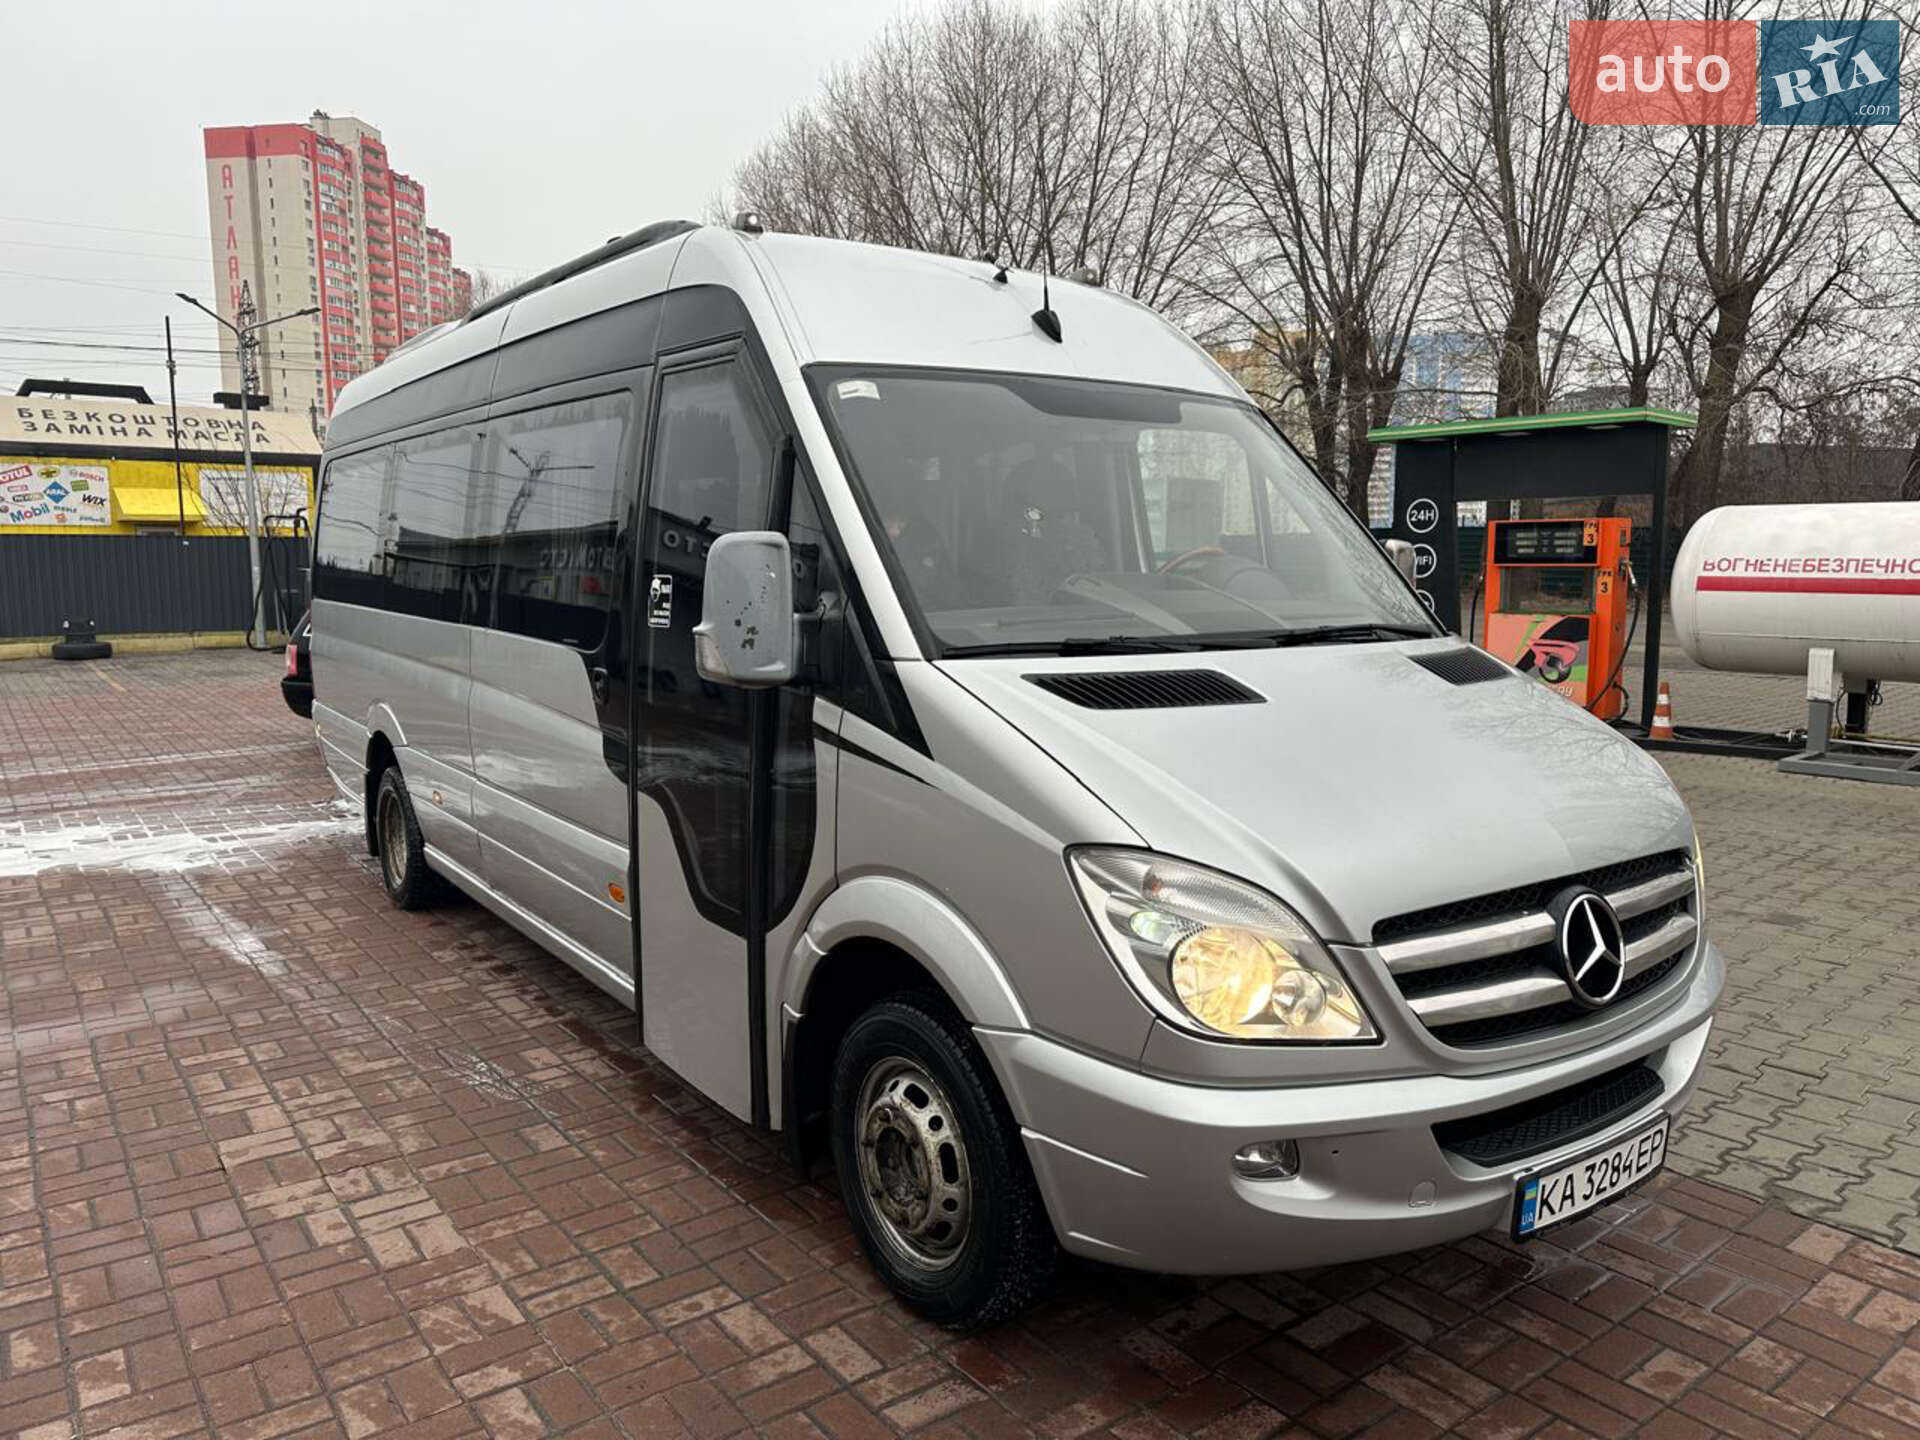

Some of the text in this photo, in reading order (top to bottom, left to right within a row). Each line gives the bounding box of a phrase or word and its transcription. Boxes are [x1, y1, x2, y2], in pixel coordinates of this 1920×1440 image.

[220, 164, 242, 328] АТЛАН
[23, 420, 153, 438] ЗАМІНА
[0, 467, 29, 482] OTUL
[82, 493, 107, 506] WIX
[10, 502, 50, 523] Mobil
[1410, 509, 1435, 521] 24H
[1600, 582, 1608, 593] 3
[1537, 1173, 1576, 1221] KA
